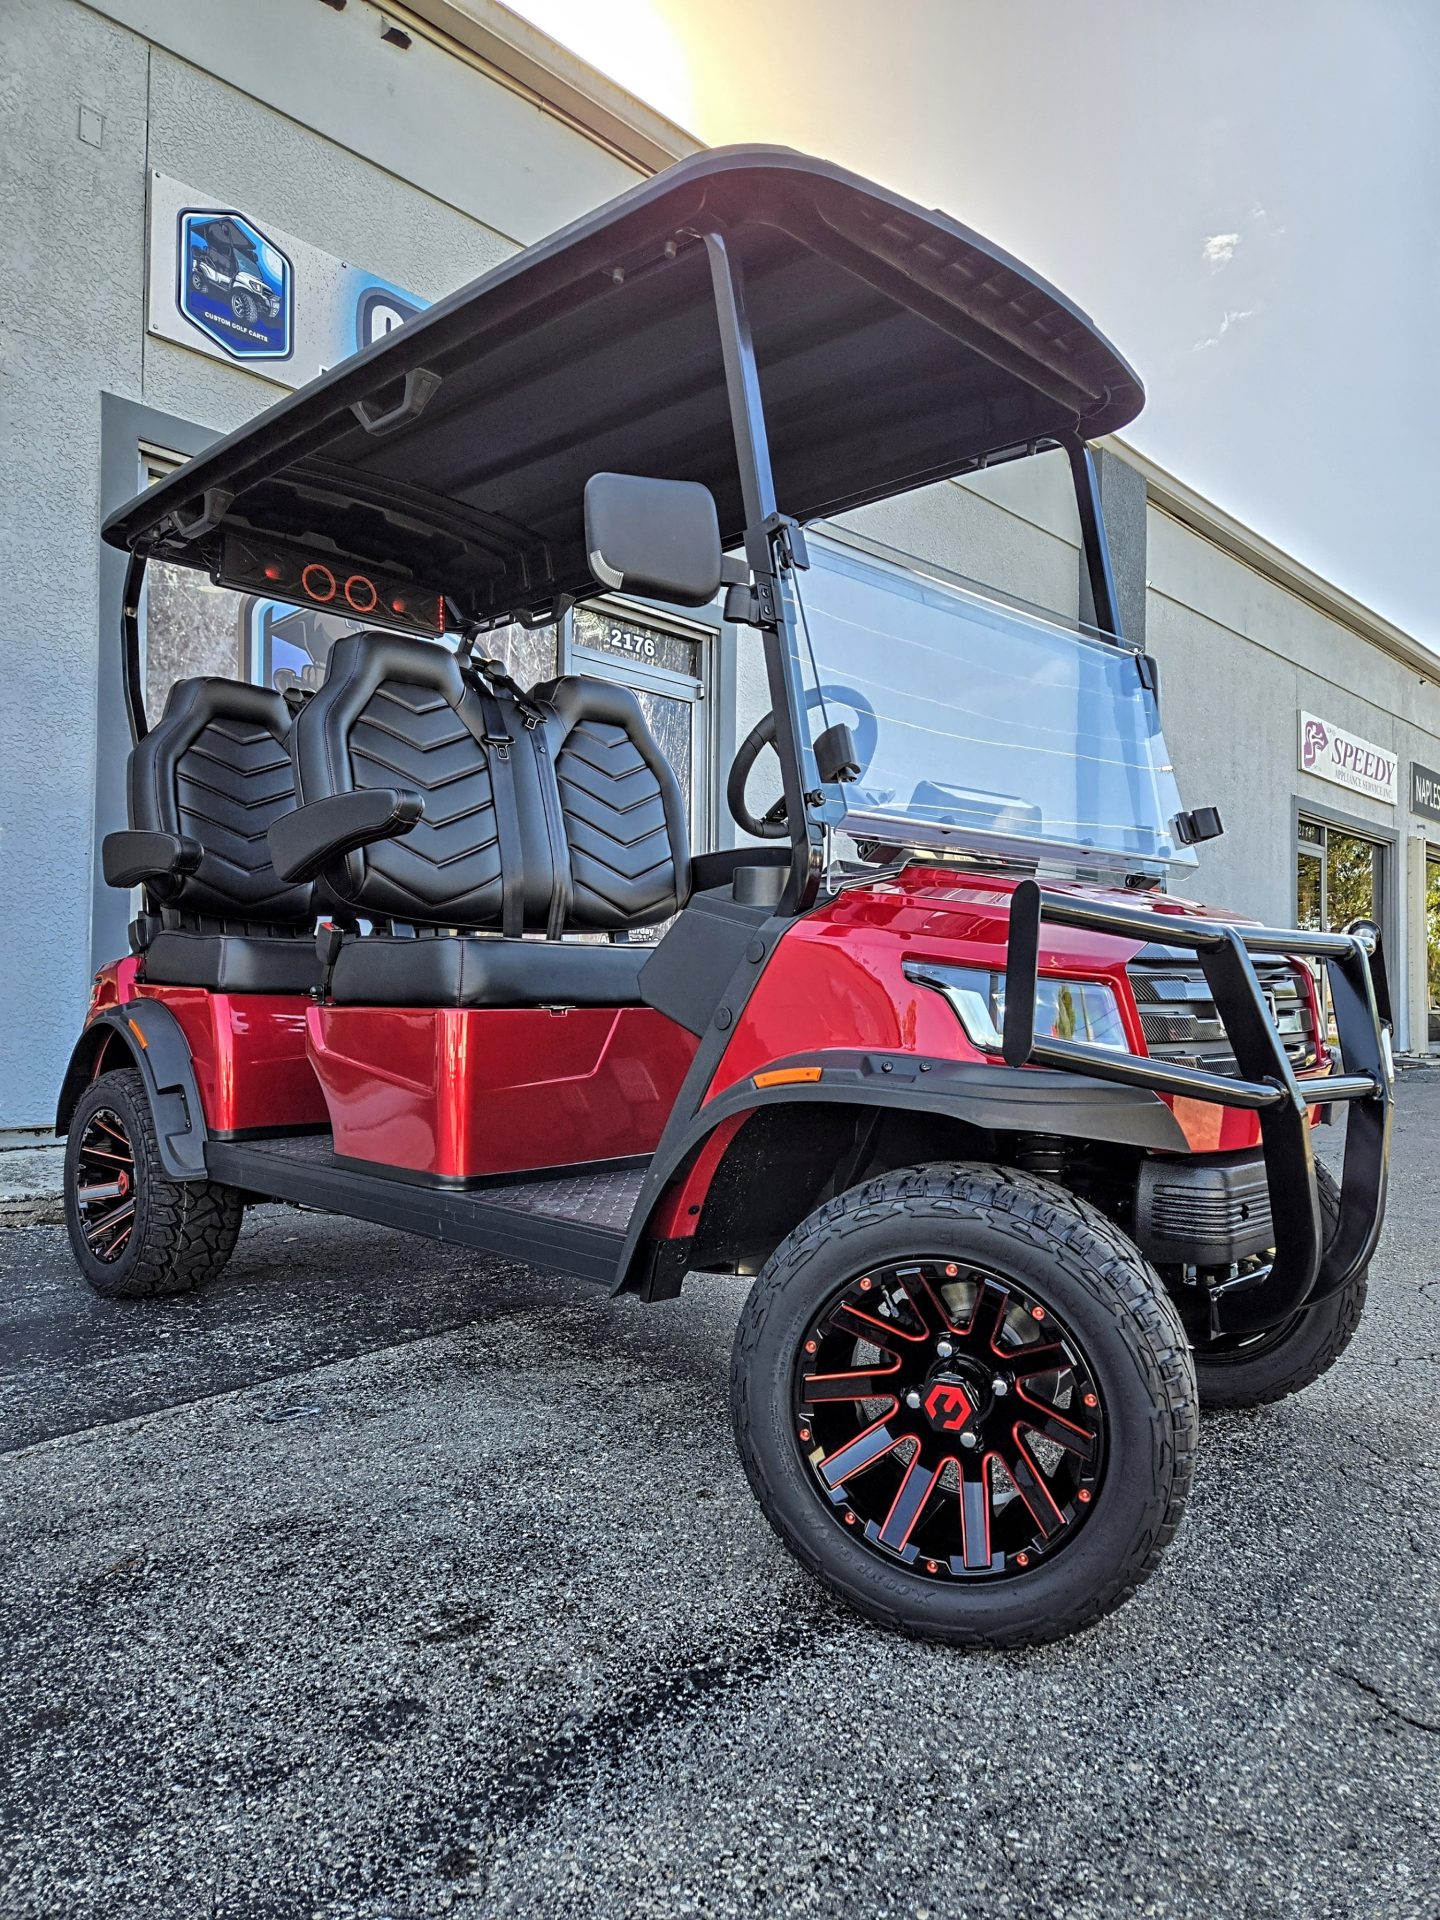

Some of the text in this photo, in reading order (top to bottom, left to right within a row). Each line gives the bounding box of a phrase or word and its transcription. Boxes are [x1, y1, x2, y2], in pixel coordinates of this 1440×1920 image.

[204, 311, 268, 342] CUSTOM GOLF CARTS
[610, 629, 655, 657] 2176
[1331, 737, 1396, 786] SPEEDY
[1415, 775, 1440, 810] NAPLES
